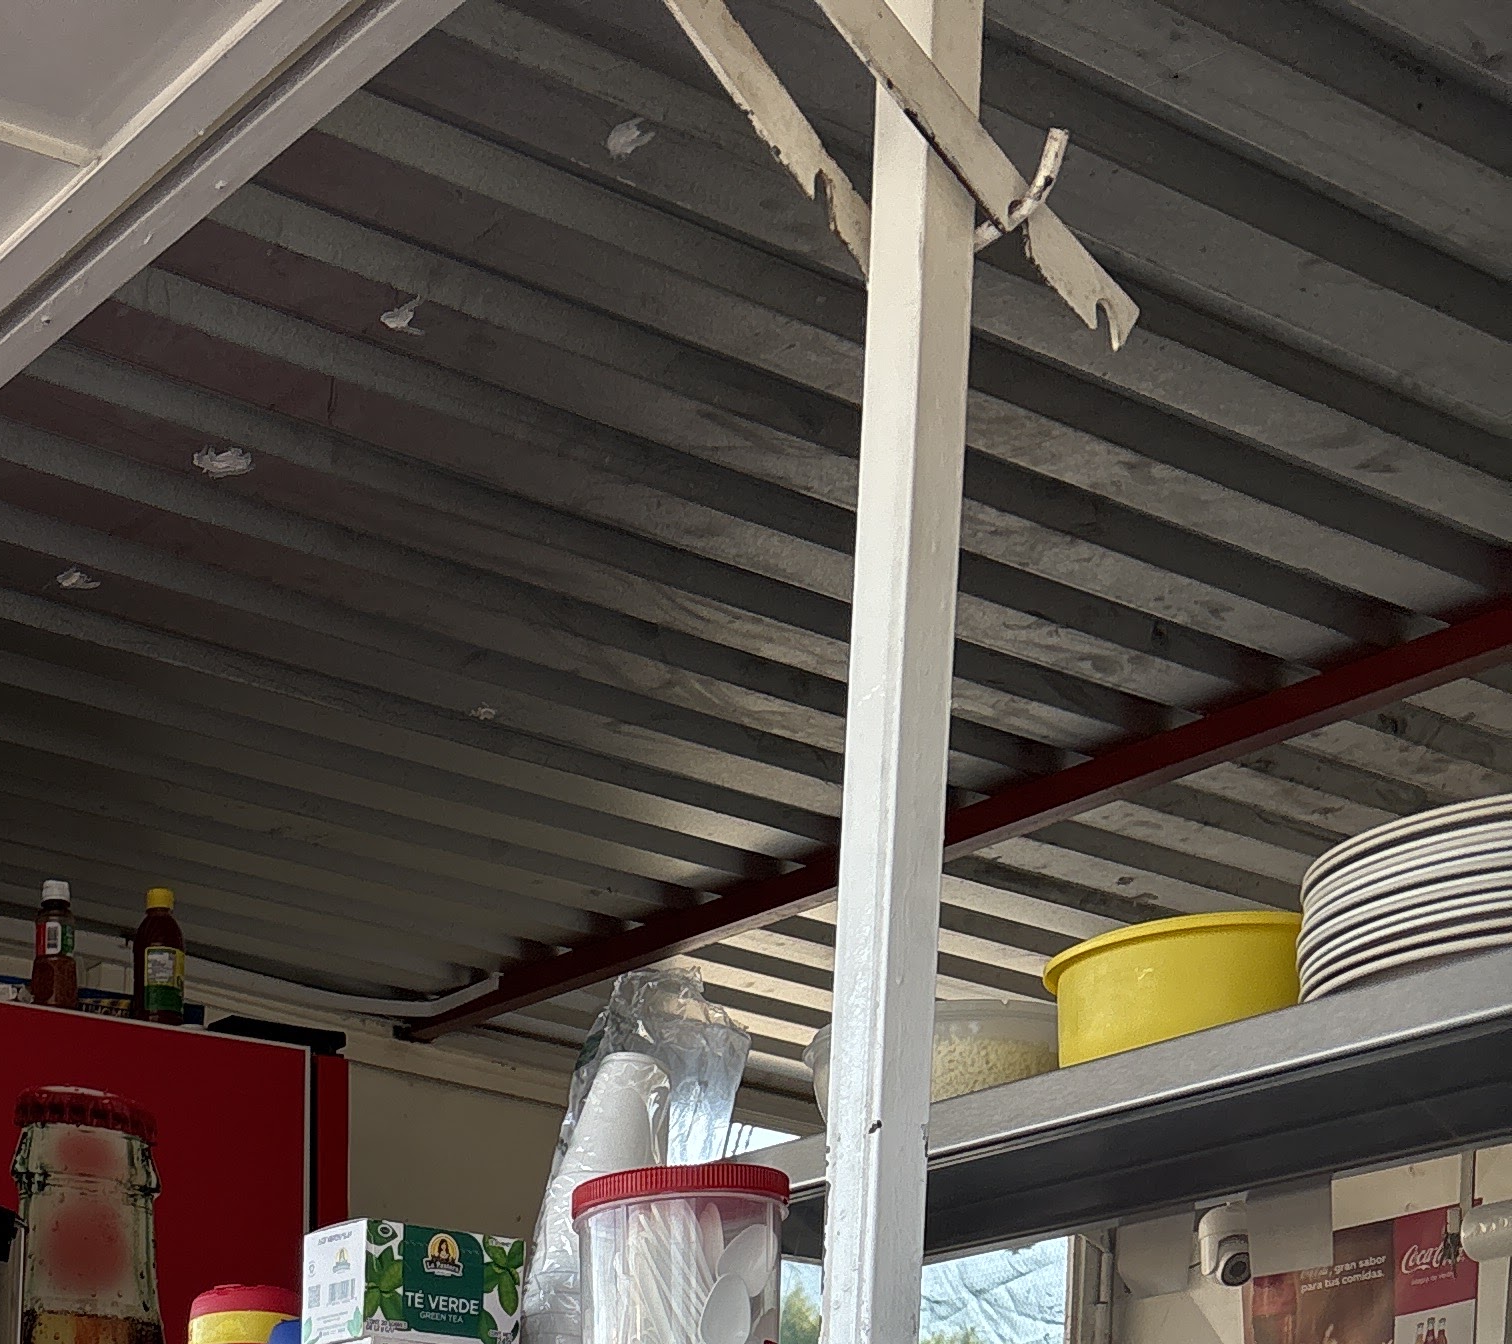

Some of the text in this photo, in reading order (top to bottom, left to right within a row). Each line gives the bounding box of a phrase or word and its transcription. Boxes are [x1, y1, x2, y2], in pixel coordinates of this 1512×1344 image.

[1334, 1261, 1356, 1274] gran
[1358, 1255, 1386, 1268] sabor
[1300, 1281, 1322, 1294] para
[405, 1290, 479, 1315] TÉ VERDE
[420, 1311, 464, 1324] GREEN TEA
